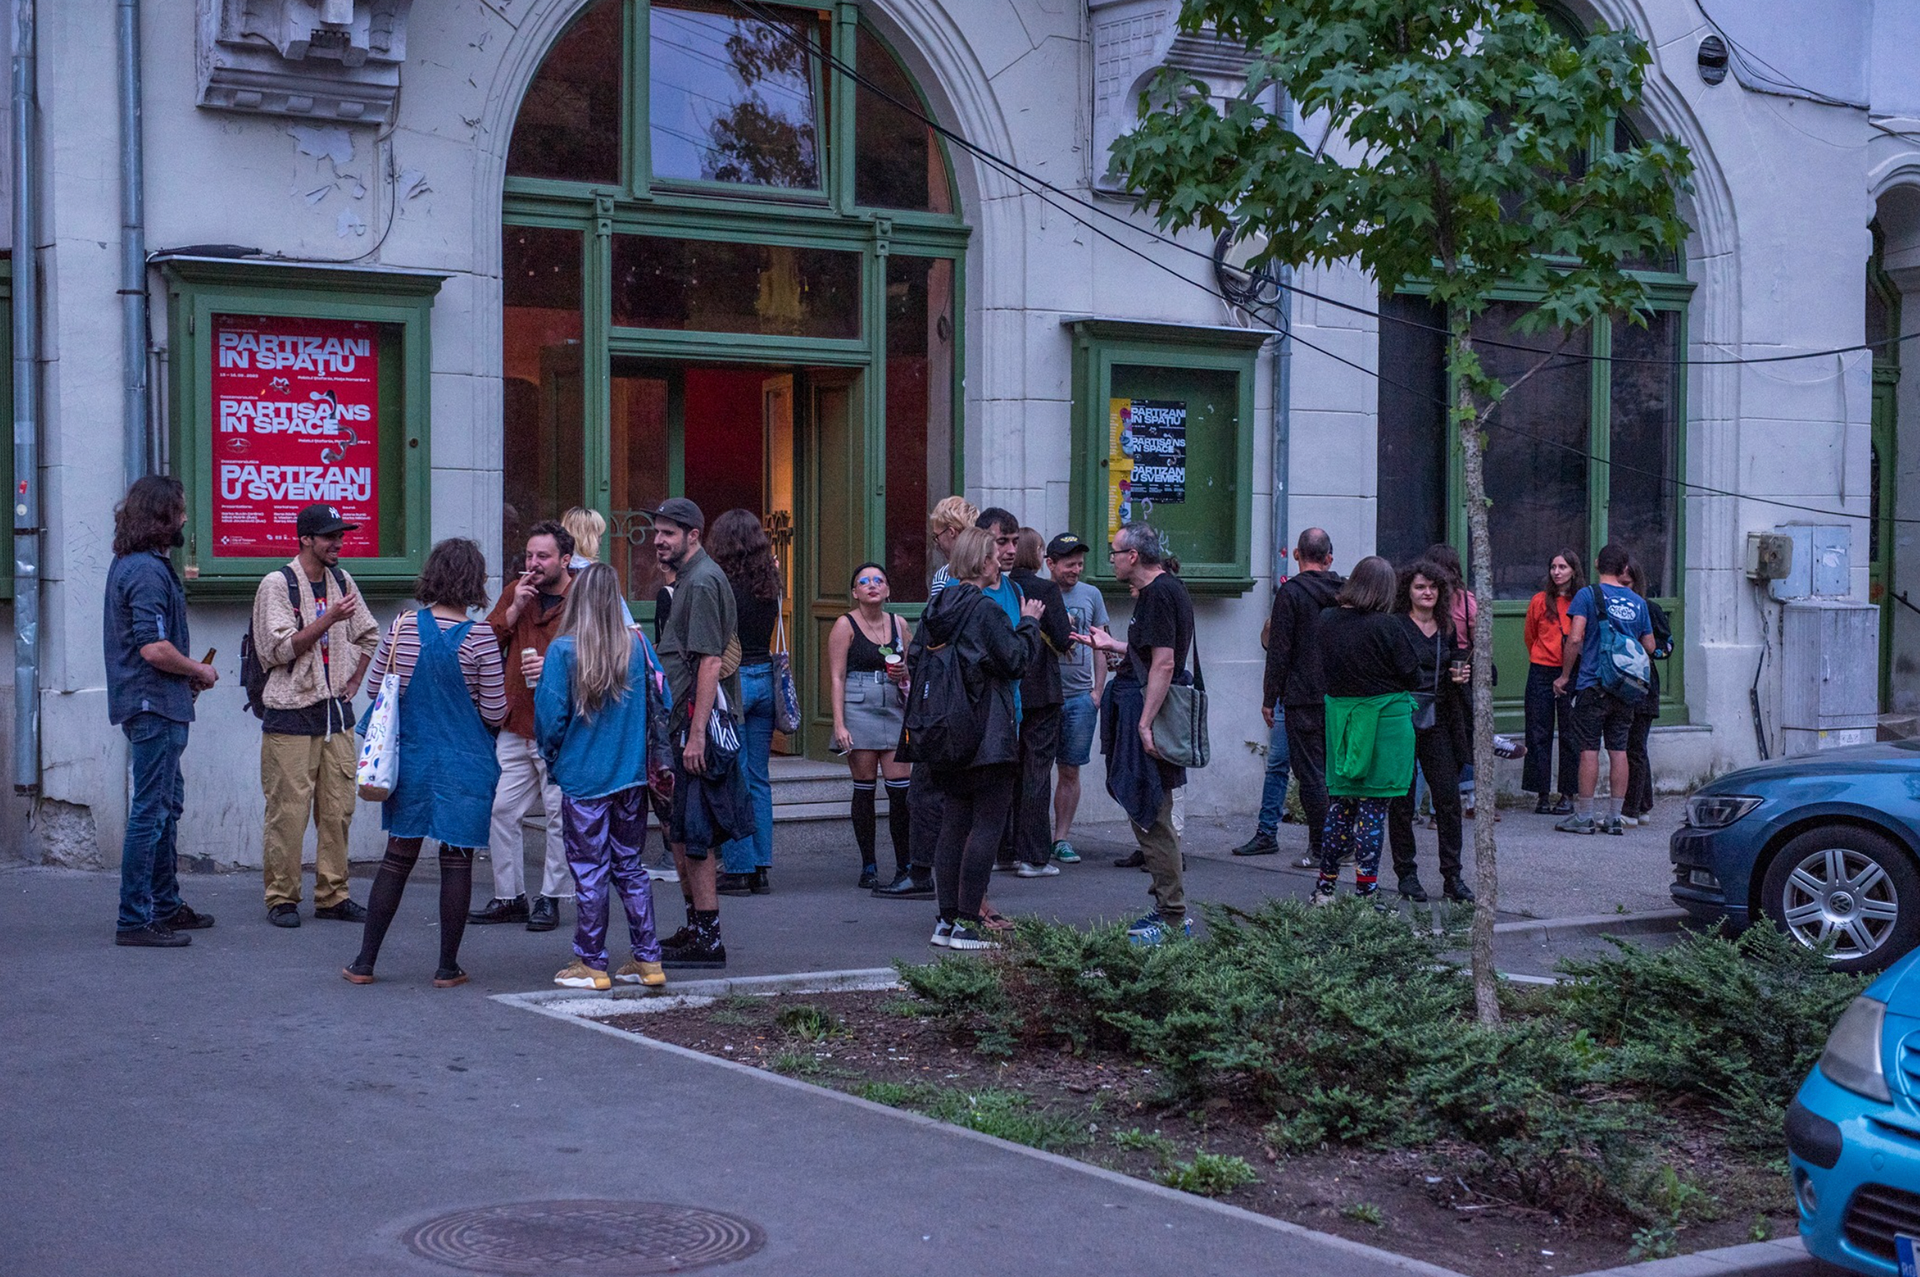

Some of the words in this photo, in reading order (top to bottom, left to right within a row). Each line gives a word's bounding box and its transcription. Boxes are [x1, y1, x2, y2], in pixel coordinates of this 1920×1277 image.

[219, 333, 370, 356] PARTIZANI
[255, 350, 355, 376] SPAȚIU
[220, 400, 371, 421] PARTISANS
[1131, 407, 1186, 418] PARTIZANI
[220, 416, 248, 432] IN
[253, 416, 339, 435] SPACE
[1132, 437, 1186, 447] PARTISANS
[1143, 445, 1174, 453] SPACE
[221, 465, 371, 484] PARTIZANI
[1140, 473, 1185, 483] SVEMIRU
[221, 482, 242, 500] U
[248, 482, 371, 501] SVEMIRU
